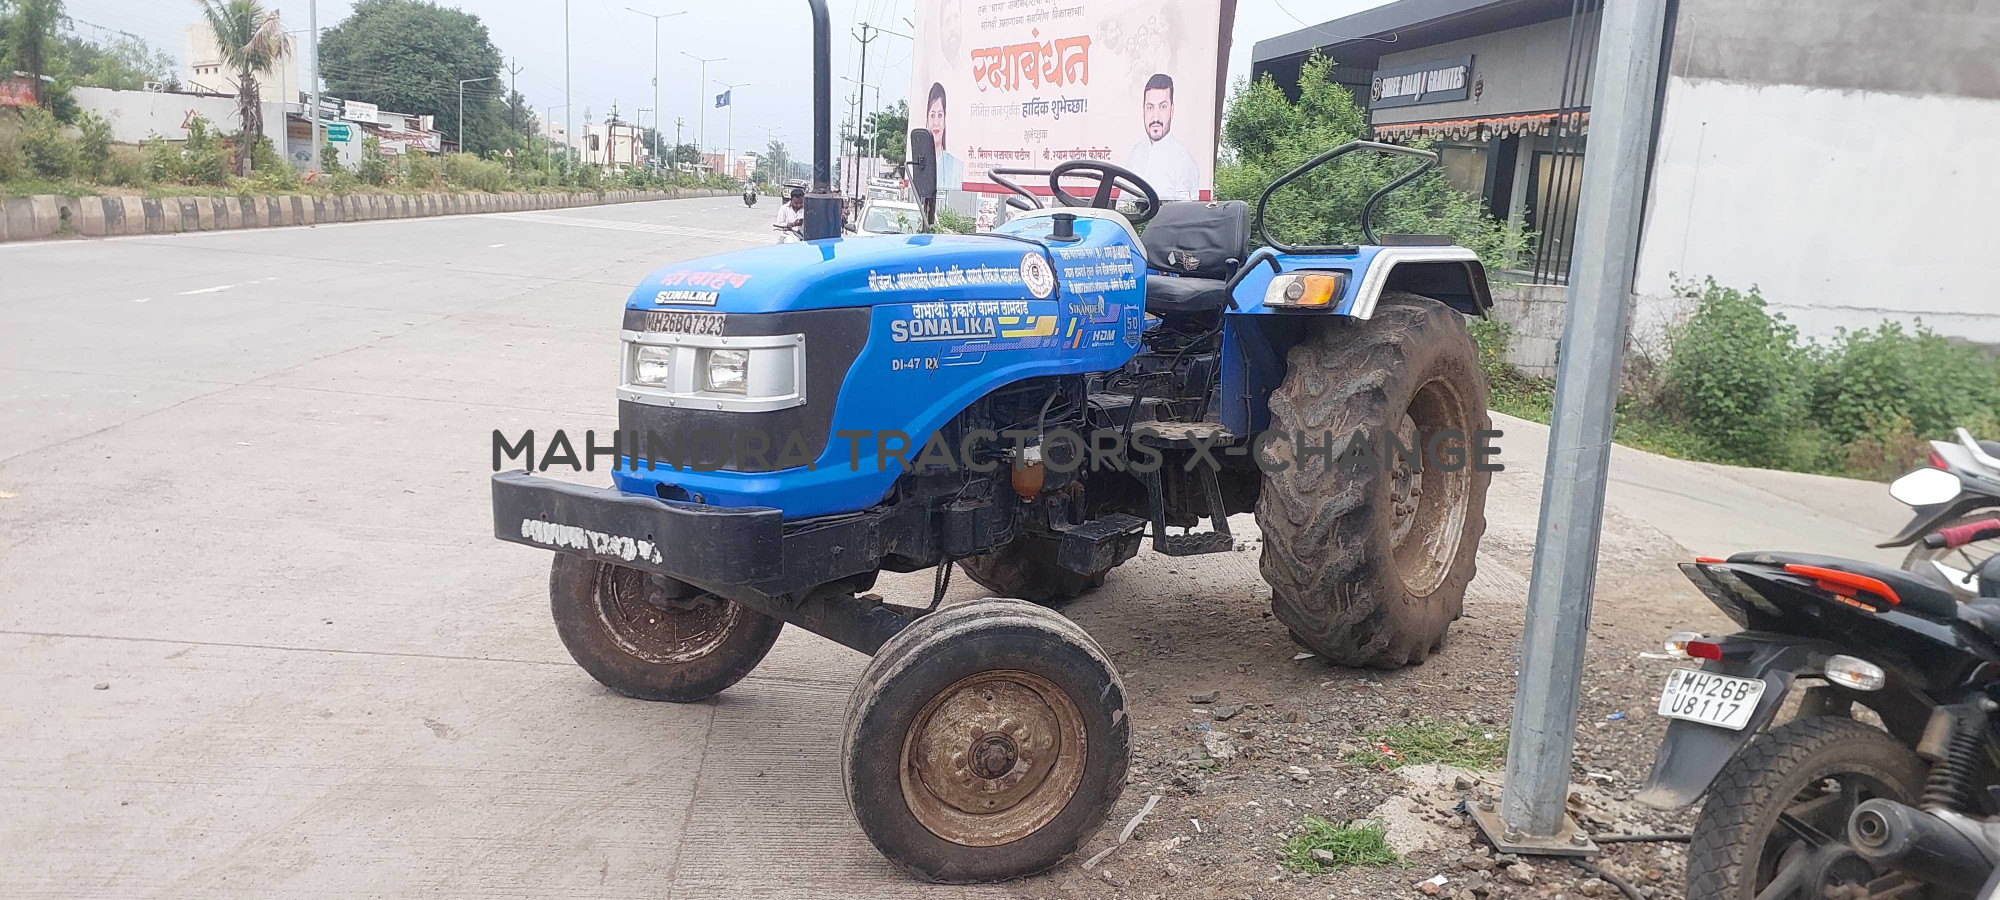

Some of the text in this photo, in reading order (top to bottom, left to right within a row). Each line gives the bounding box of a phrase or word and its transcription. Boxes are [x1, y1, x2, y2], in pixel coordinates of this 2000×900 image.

[970, 28, 1092, 93] रक्षाबंधन
[1381, 75, 1400, 98] SHREE
[1427, 65, 1466, 92] GRANITES
[970, 103, 990, 118] निमित्त
[1022, 97, 1049, 118] हार्दिक
[1051, 95, 1088, 120] शुभेच्छा!
[1023, 127, 1048, 143] शुभेच्छुक
[1014, 148, 1031, 160] पाटील
[1068, 147, 1087, 160] पाटील
[1088, 146, 1112, 160] कोकाटे
[655, 290, 719, 306] SONALIKA
[950, 301, 977, 318] प्रकाश
[977, 301, 999, 316] वामन
[646, 312, 725, 336] MH26BQ7323
[891, 317, 996, 342] SONALIKA
[1127, 316, 1138, 330] 50
[1093, 329, 1116, 341] HDM
[892, 357, 920, 371] DI-47
[1679, 672, 1750, 701] MH26B
[1671, 693, 1740, 722] U8117
